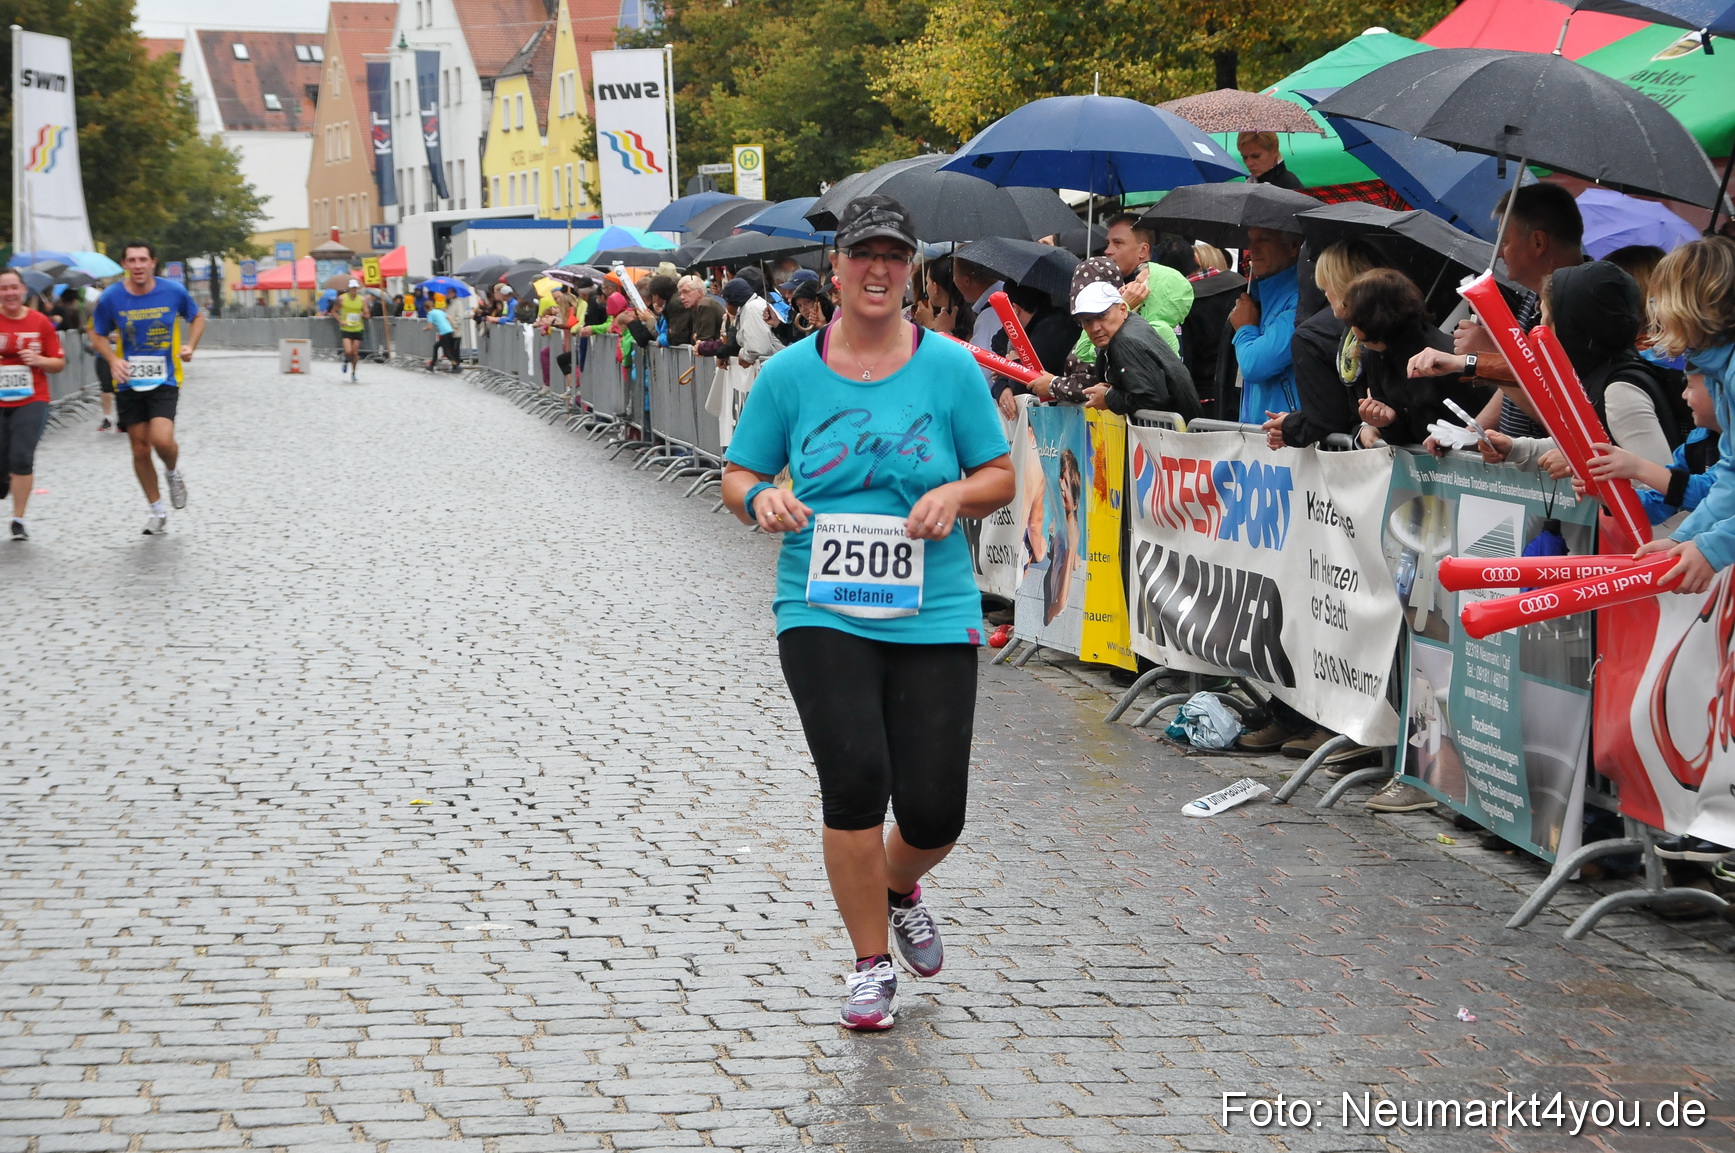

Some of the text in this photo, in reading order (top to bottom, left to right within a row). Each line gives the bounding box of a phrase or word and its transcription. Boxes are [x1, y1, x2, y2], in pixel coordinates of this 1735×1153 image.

[1508, 327, 1535, 363] Audi
[129, 364, 162, 377] 2384
[800, 411, 935, 488] Style
[816, 524, 904, 536] PARTL Neumarkt
[821, 539, 912, 579] 2508
[1321, 553, 1358, 593] Herzen
[1536, 567, 1571, 580] BKK
[833, 586, 894, 604] Stefanie
[1572, 571, 1653, 601] BKK Audi
